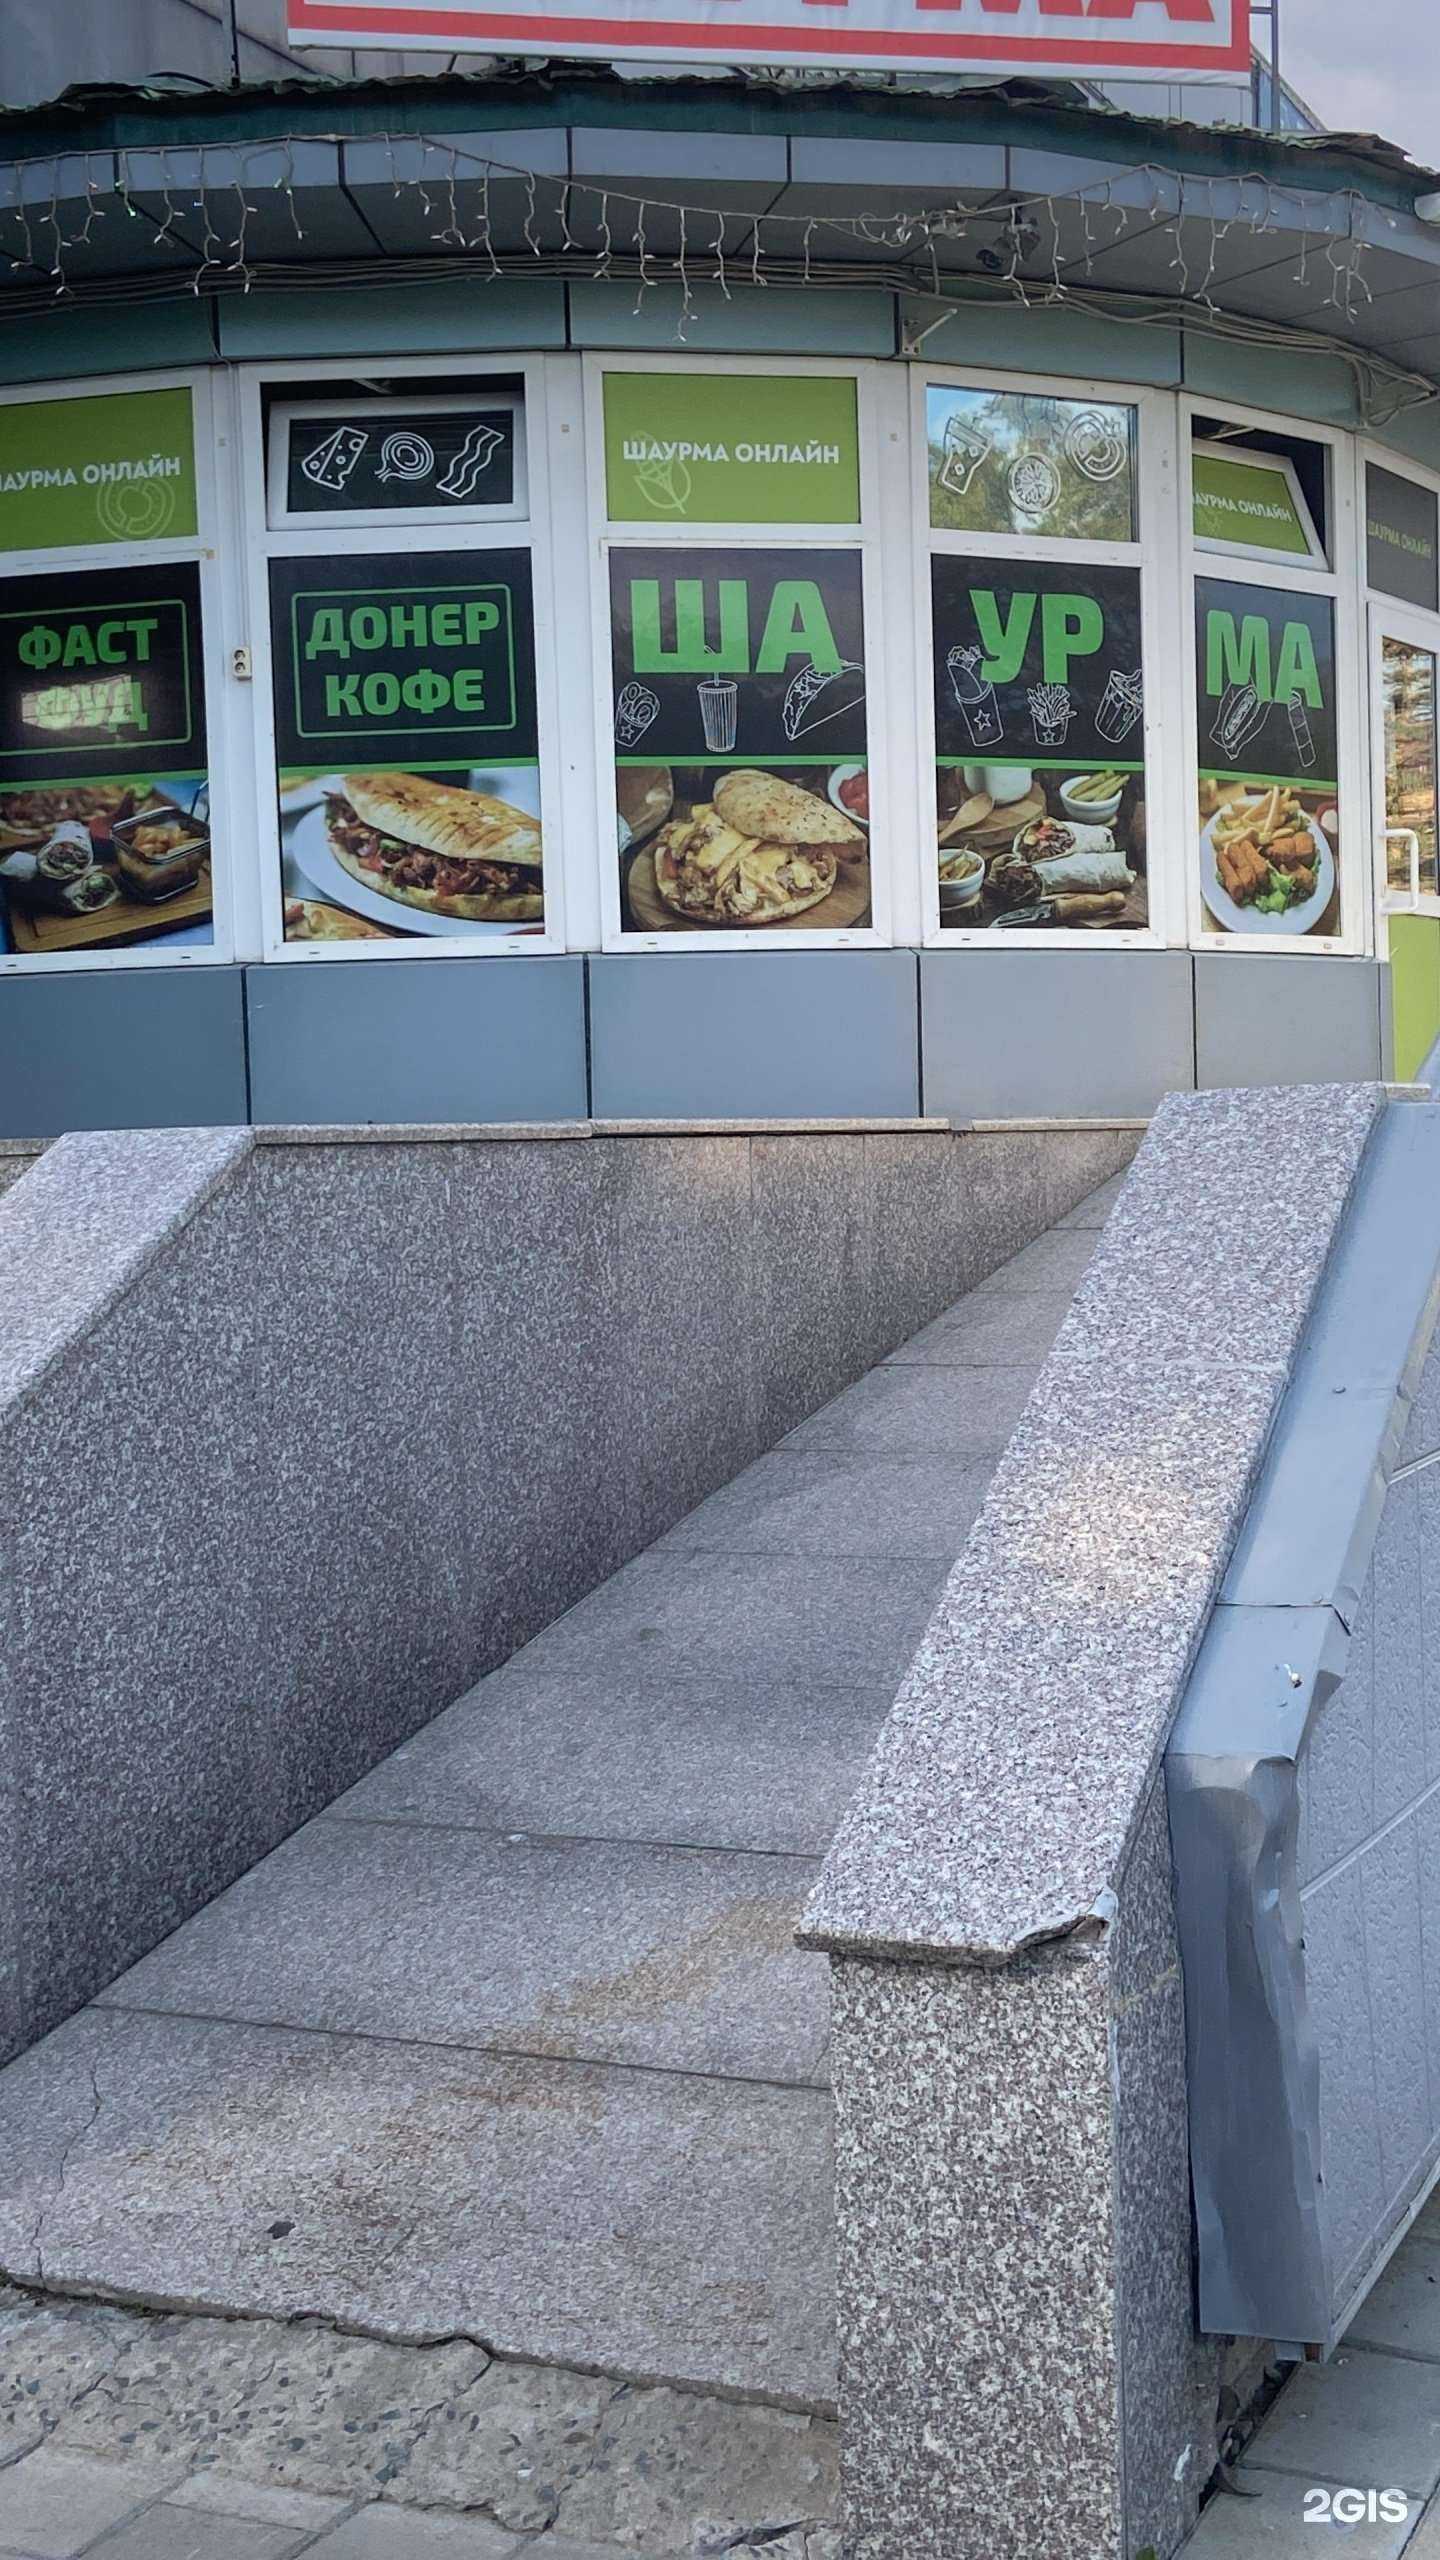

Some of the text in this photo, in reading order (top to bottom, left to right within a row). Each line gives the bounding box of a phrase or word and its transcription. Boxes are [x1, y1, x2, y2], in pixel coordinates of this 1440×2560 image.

[82, 453, 181, 484] ОНЛАЙН
[623, 440, 839, 464] ШАУРМА ОНЛАЙН
[1193, 492, 1293, 522] АУРМА ОНЛАЙН
[18, 618, 158, 669] ФАСТ
[305, 601, 499, 660] ДОНЕР
[630, 579, 843, 674] ША
[969, 588, 1104, 684] УР
[1206, 609, 1324, 709] МА
[325, 669, 485, 717] КОФЕ
